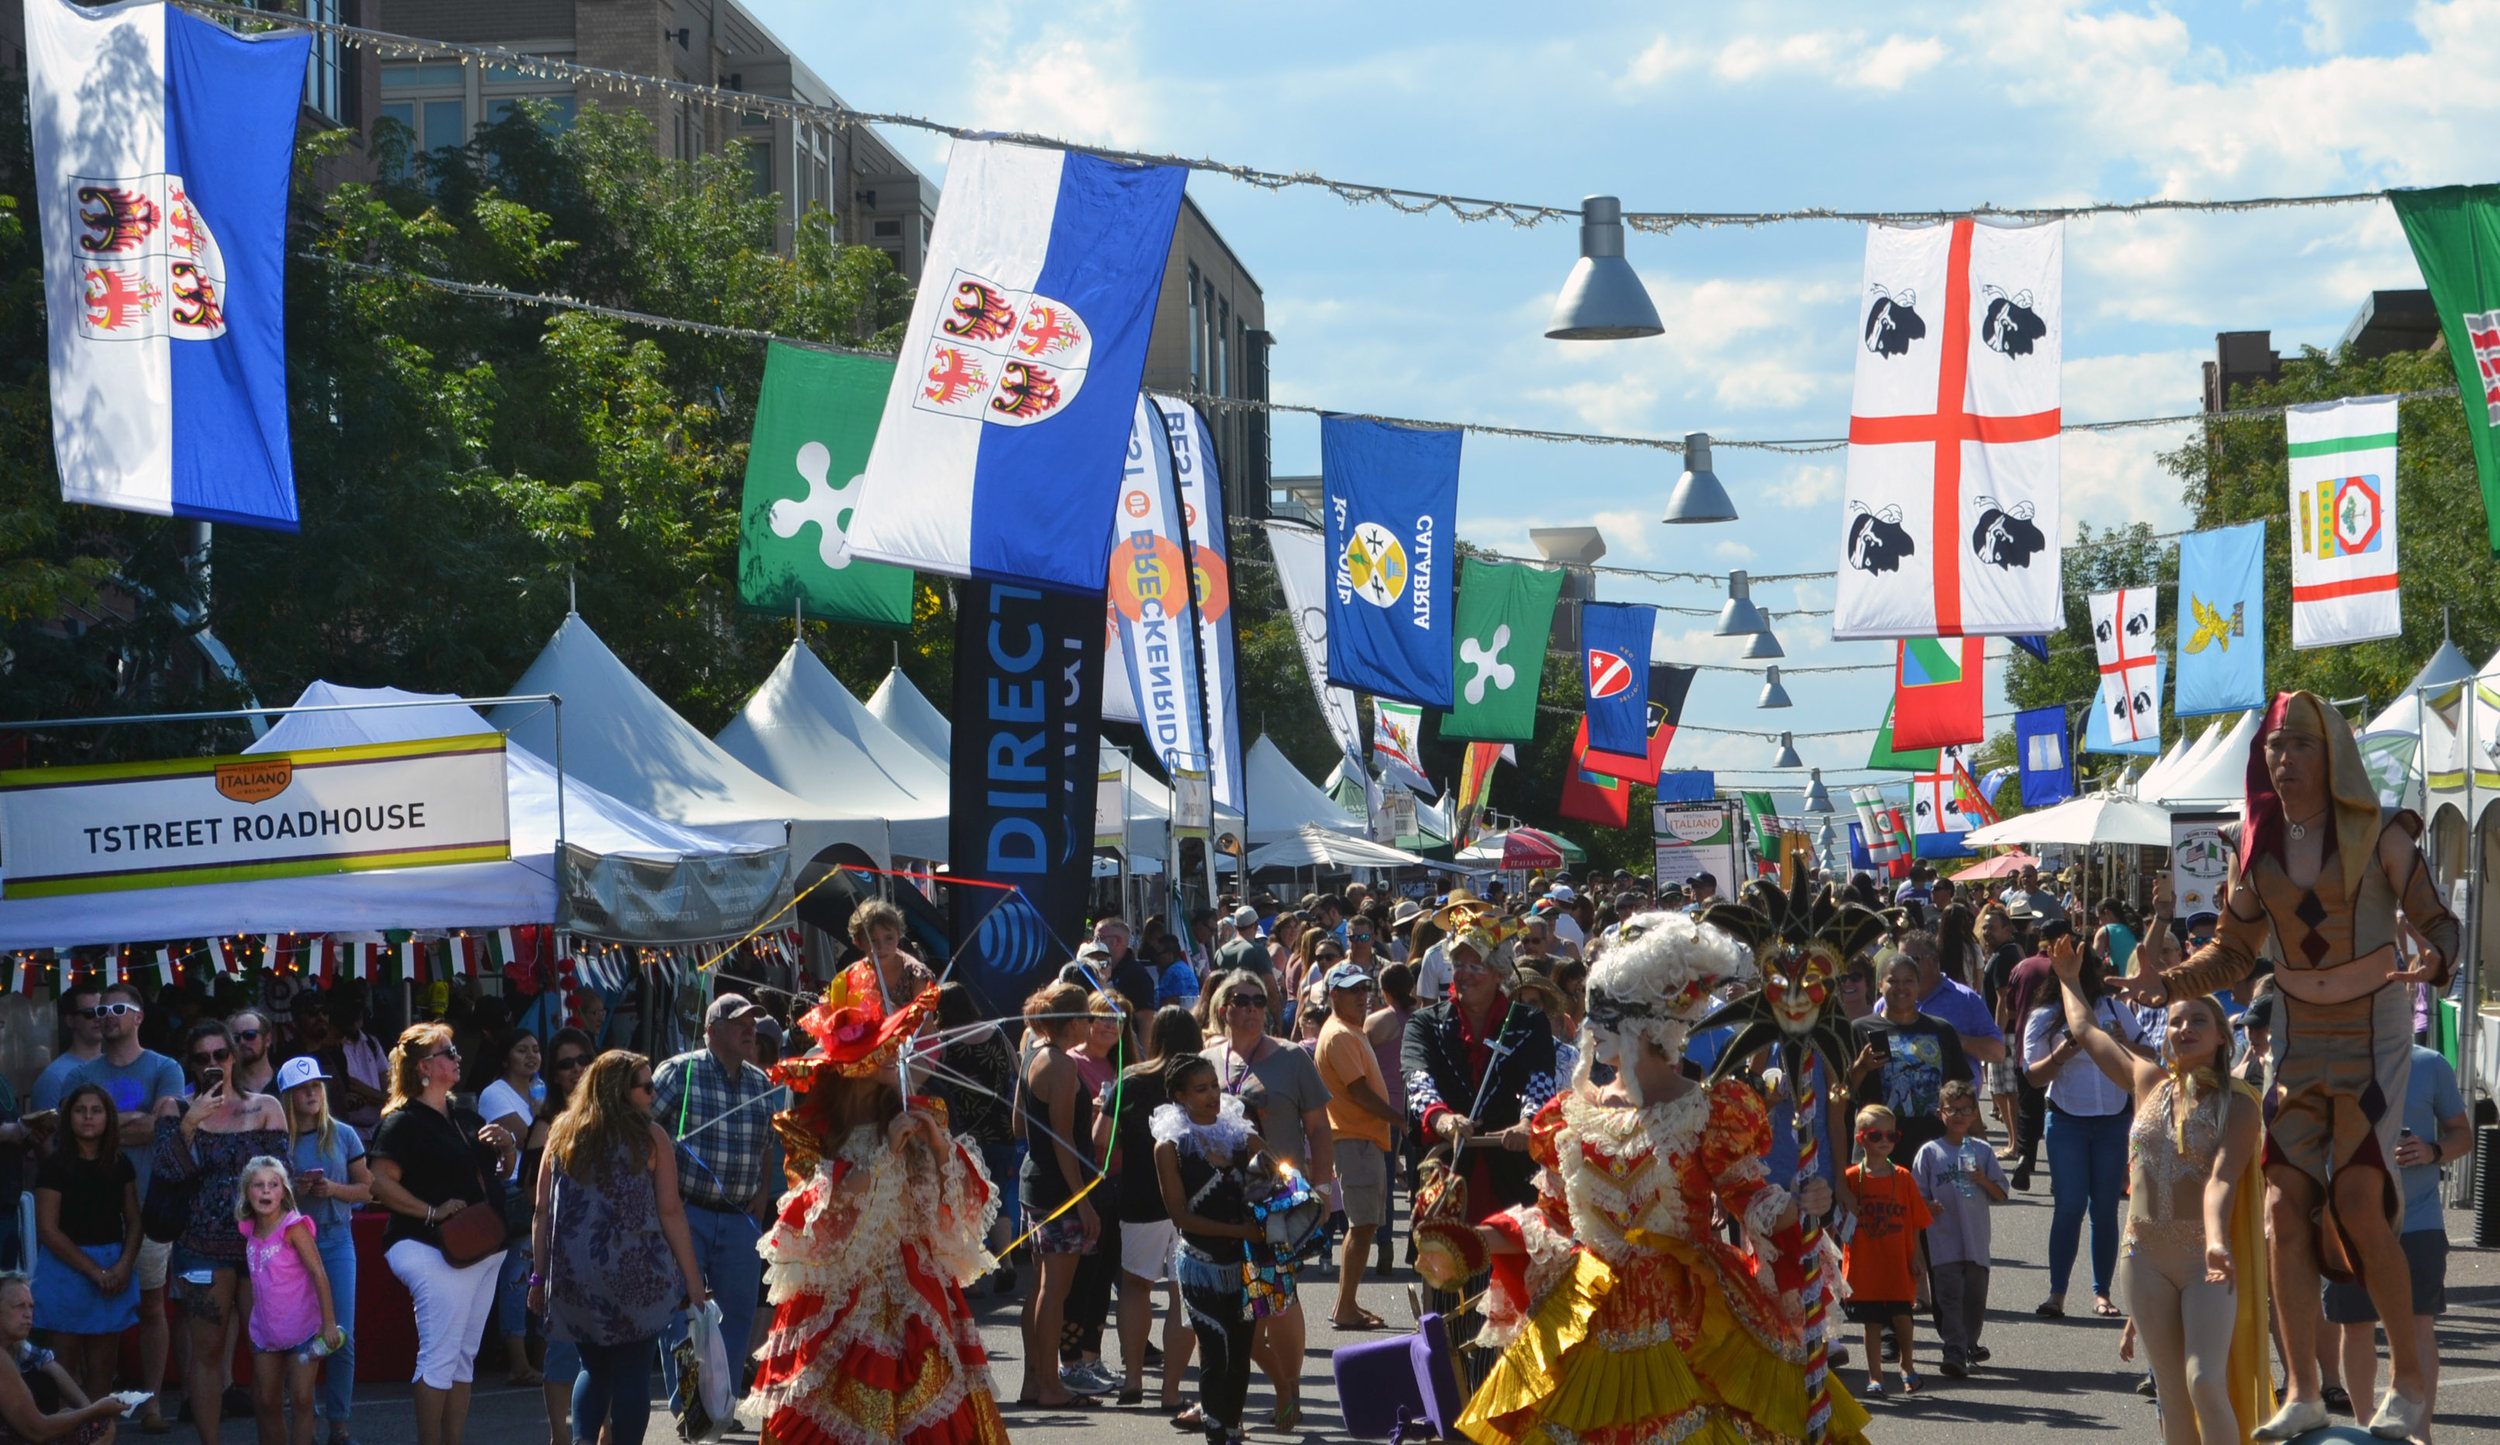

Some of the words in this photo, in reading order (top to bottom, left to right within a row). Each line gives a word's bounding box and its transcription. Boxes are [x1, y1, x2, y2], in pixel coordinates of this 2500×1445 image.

[221, 771, 287, 789] ITALIANO
[84, 818, 223, 854] TSTREET
[233, 802, 426, 843] ROADHOUSE
[1670, 818, 1720, 830] ITALIANO
